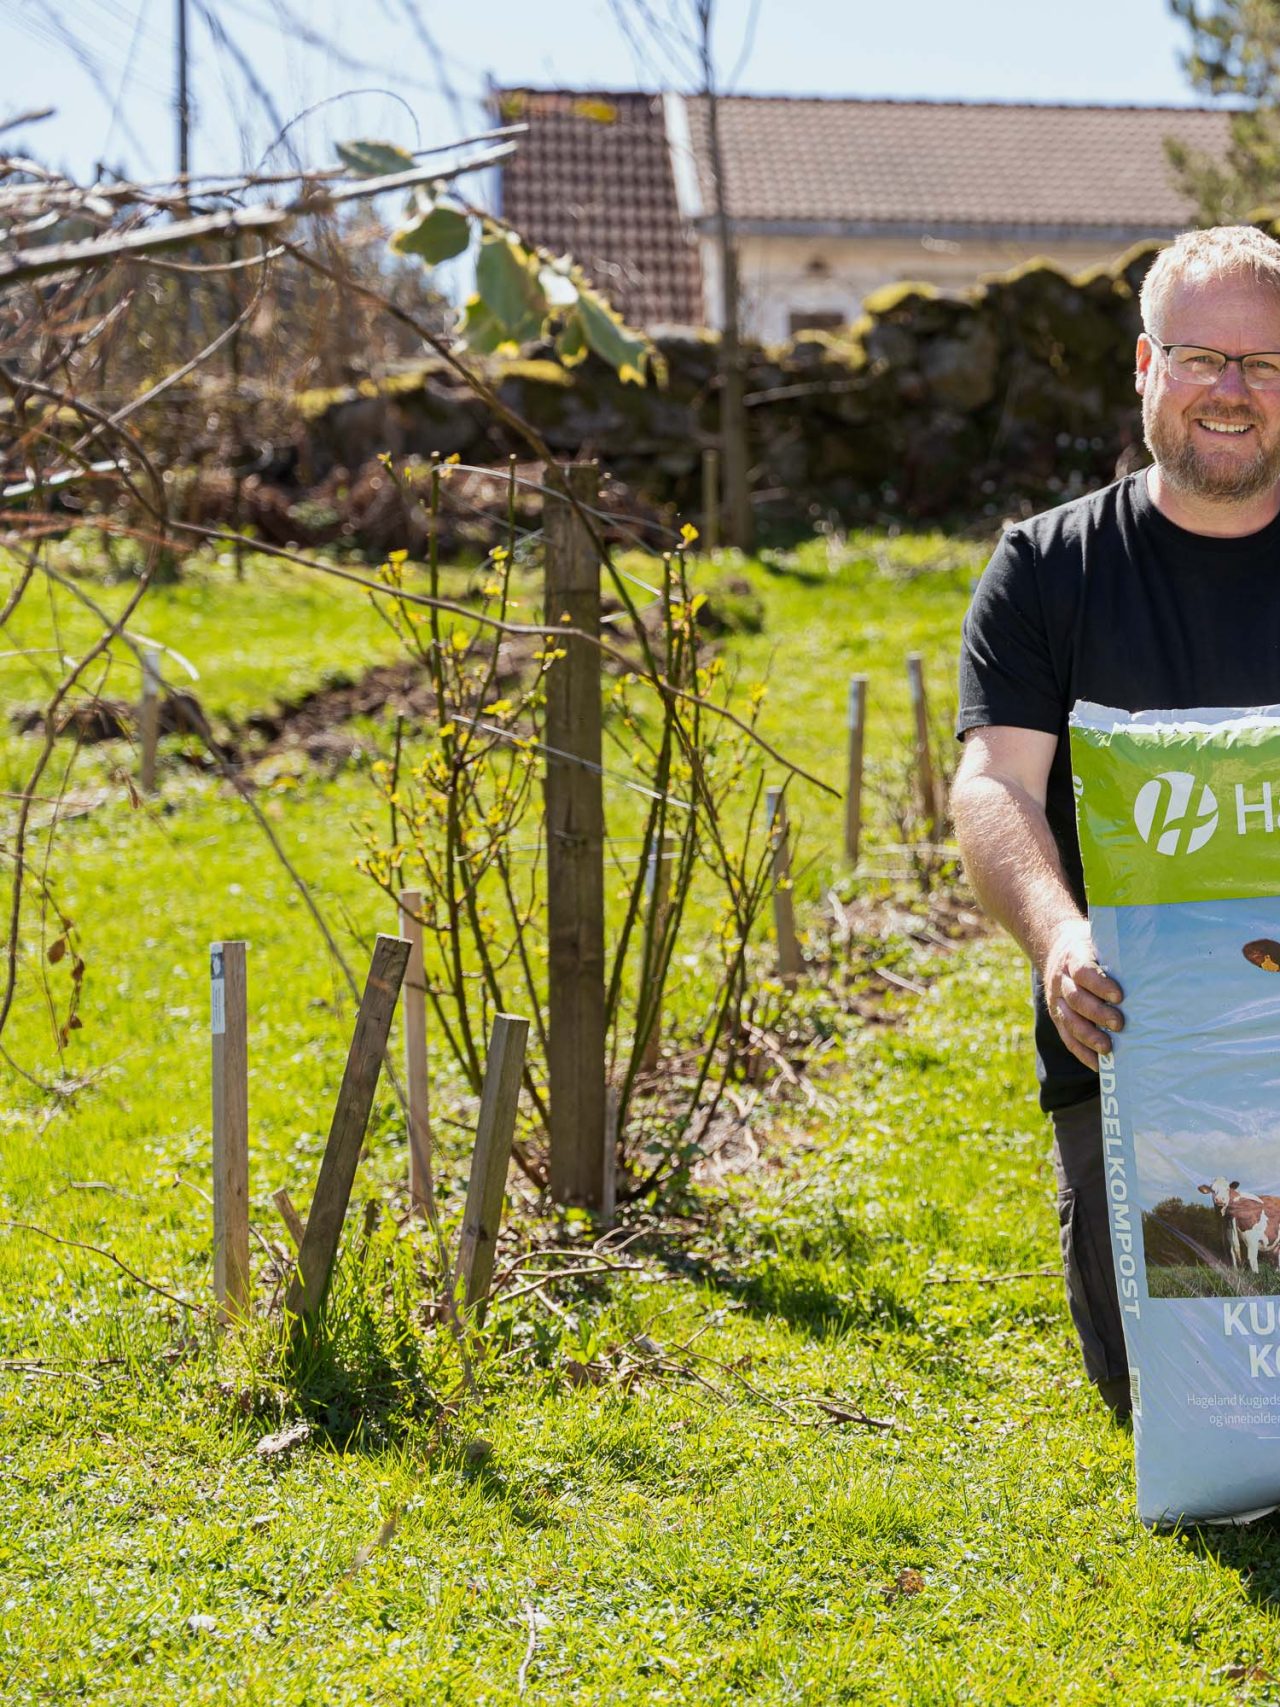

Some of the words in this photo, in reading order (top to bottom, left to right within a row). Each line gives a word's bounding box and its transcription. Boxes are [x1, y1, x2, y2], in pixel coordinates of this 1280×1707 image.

[1099, 1051, 1141, 1321] ØDSELKOMPOST
[1187, 1392, 1237, 1409] Hageland
[1209, 1414, 1224, 1428] og
